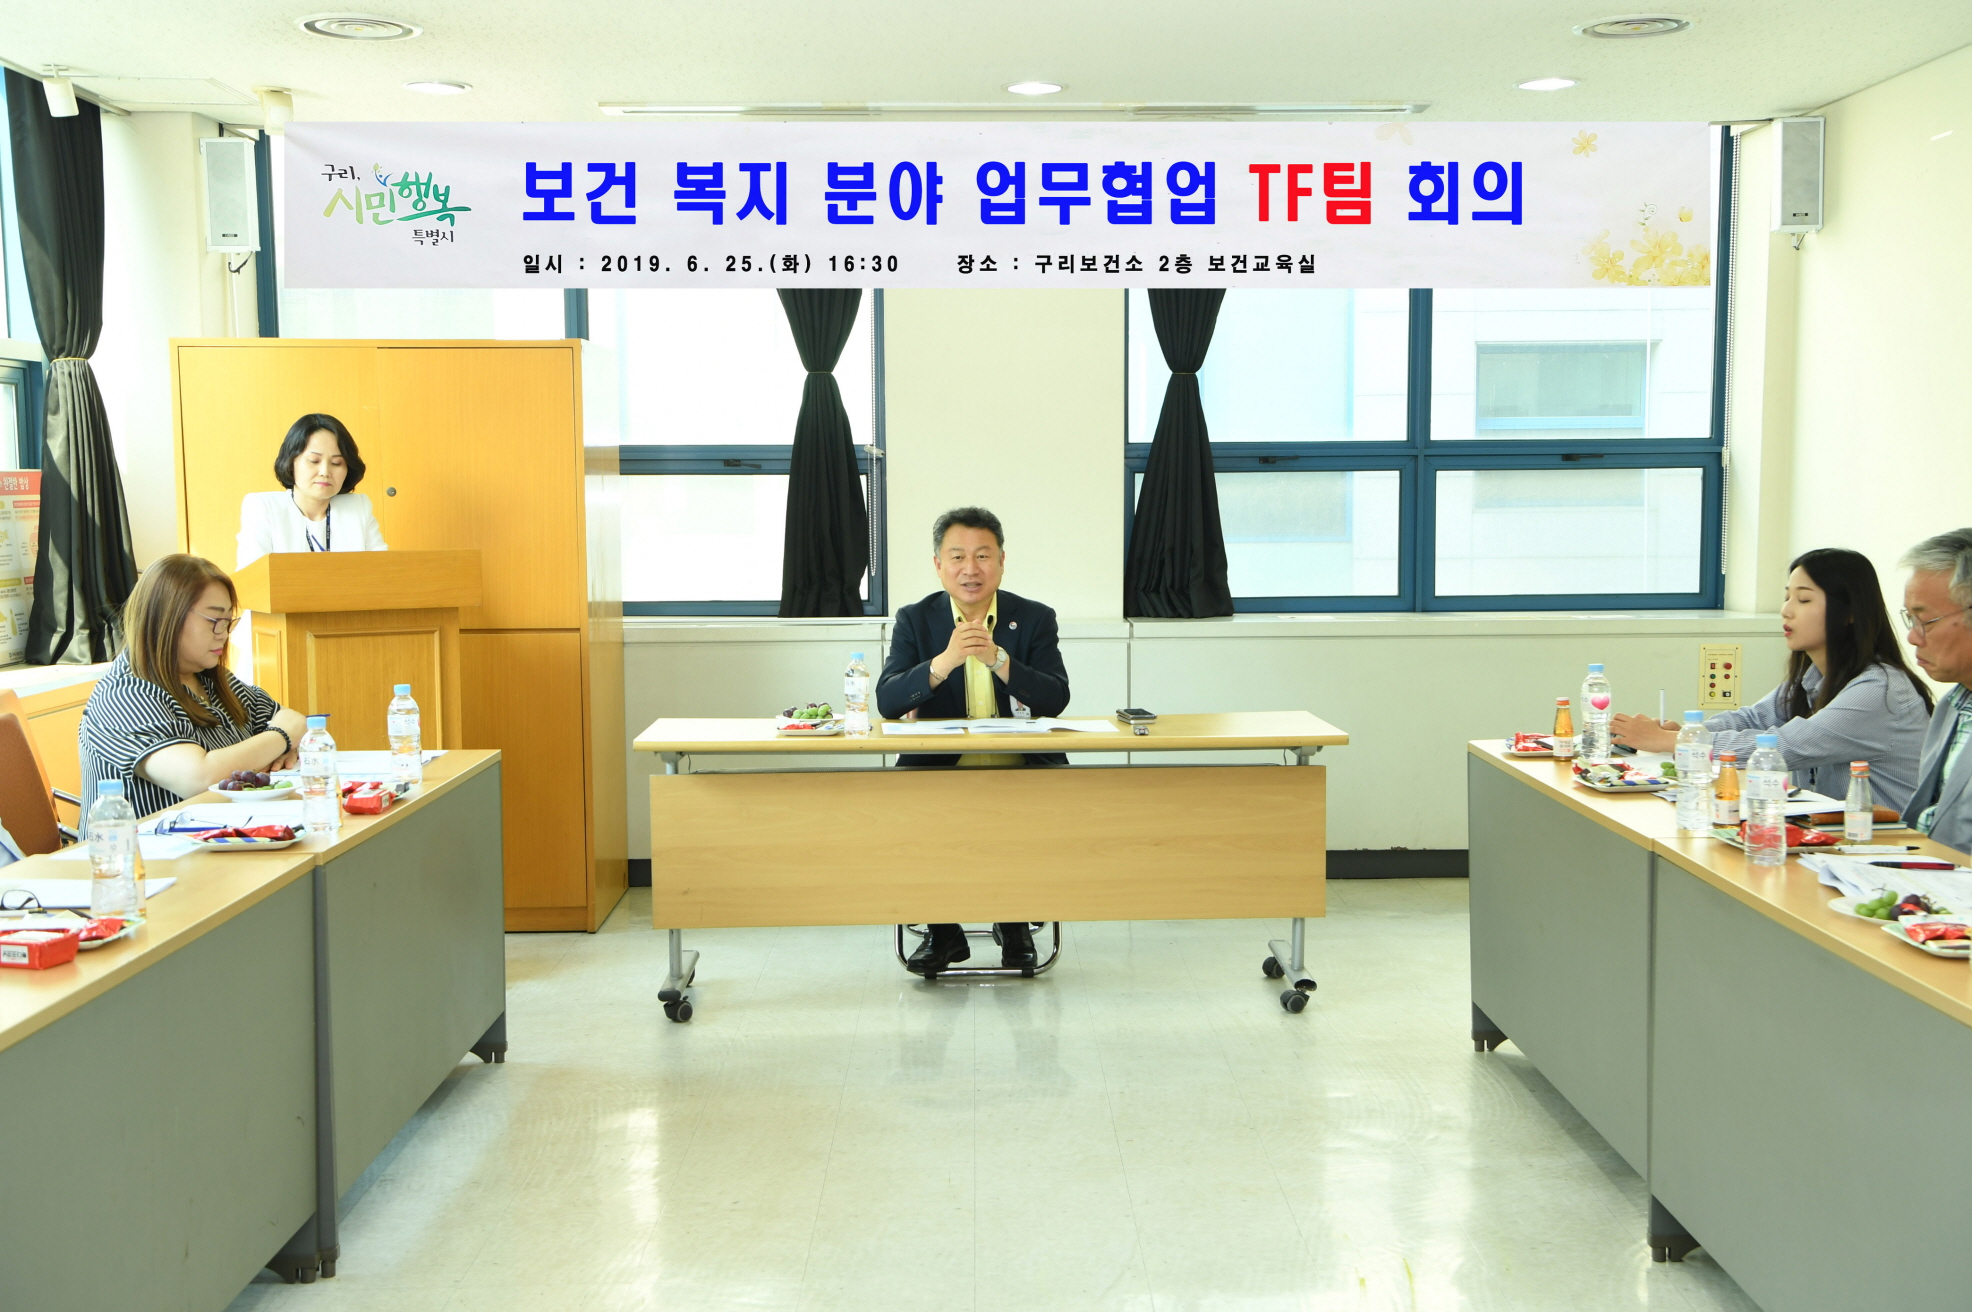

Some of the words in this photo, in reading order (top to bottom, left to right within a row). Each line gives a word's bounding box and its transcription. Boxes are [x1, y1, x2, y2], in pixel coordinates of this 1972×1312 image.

[321, 164, 361, 182] 구리,
[522, 161, 637, 225] 보건
[673, 161, 787, 226] 복지
[824, 161, 944, 226] 분야
[976, 161, 1216, 226] 업무협업
[1248, 161, 1372, 225] TF팀
[1408, 161, 1523, 226] 회의
[412, 229, 454, 246] 특별시
[523, 254, 562, 274] 일시
[601, 254, 670, 273] 2019.
[687, 254, 709, 273] 6.
[725, 253, 811, 274] 25.(화)
[828, 254, 898, 273] 16:30
[956, 254, 998, 275] 장소
[1034, 254, 1143, 274] 구리보건소
[1158, 253, 1193, 275] 2층
[1207, 254, 1315, 274] 보건교육실
